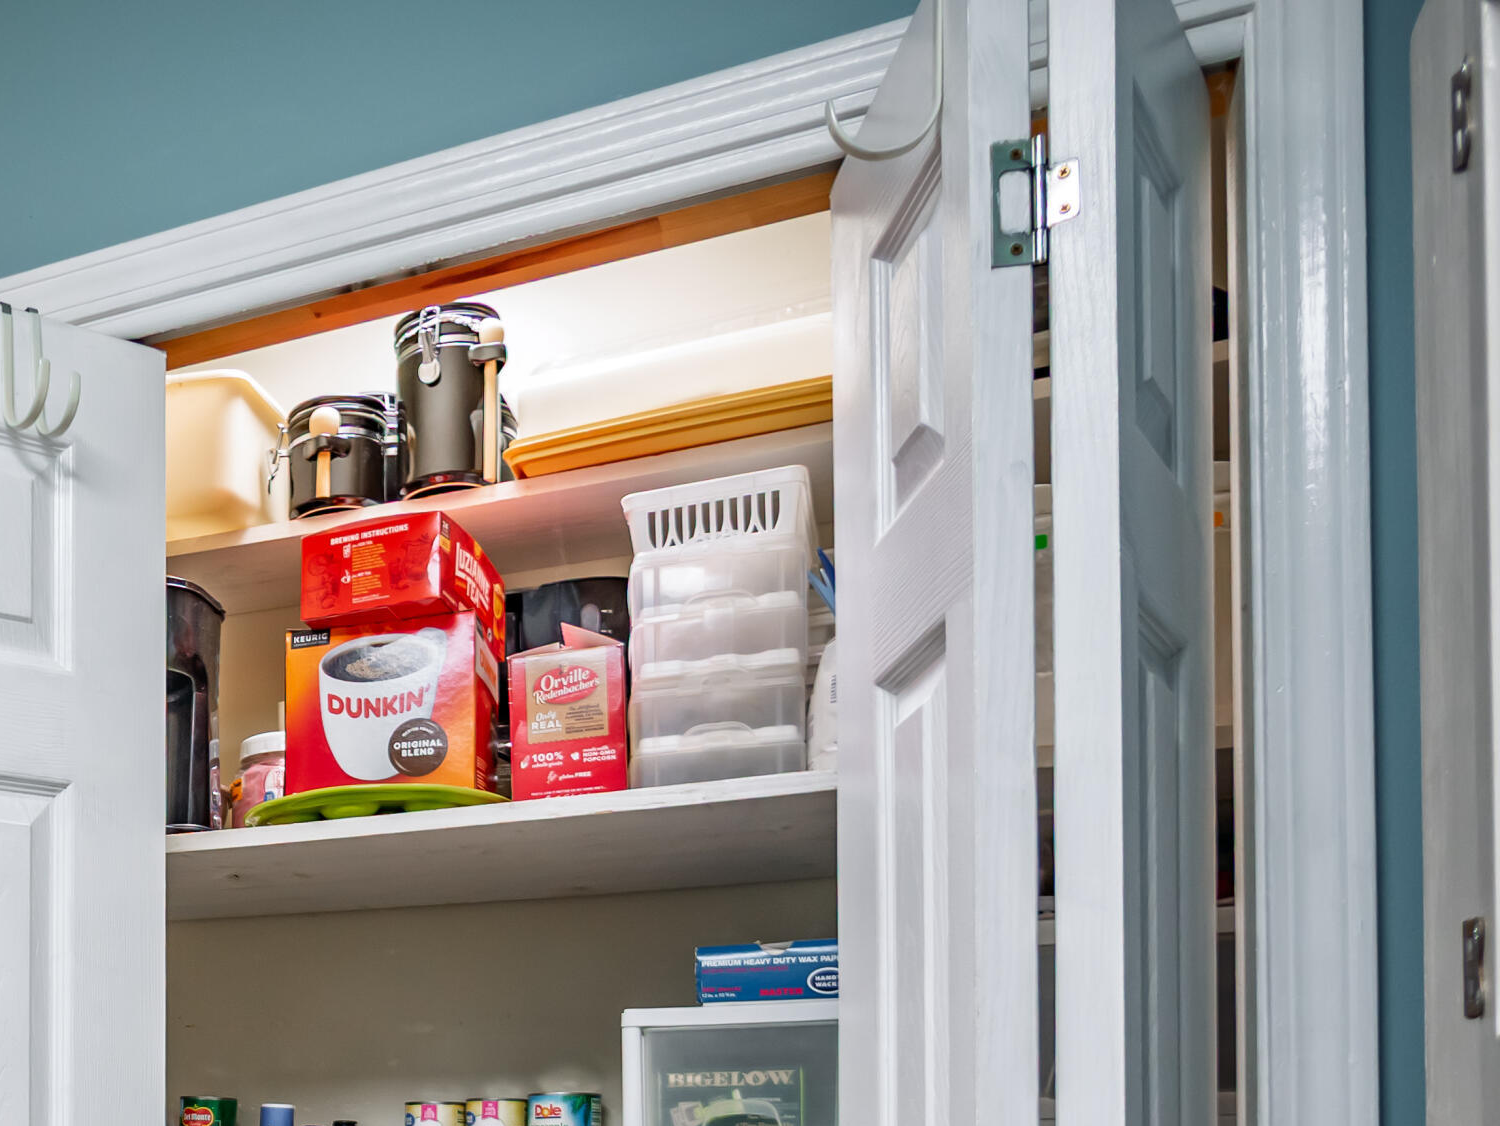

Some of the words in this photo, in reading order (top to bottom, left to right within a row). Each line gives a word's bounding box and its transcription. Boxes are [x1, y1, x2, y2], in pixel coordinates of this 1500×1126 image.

[330, 533, 360, 546] BREWING
[360, 523, 409, 539] INSTRUCTIONS
[455, 542, 490, 603] LUZIANNE
[466, 577, 489, 611] TEA
[293, 633, 328, 644] KEURIG
[540, 668, 590, 691] Orville
[533, 676, 600, 705] Redenbacher's
[327, 684, 431, 719] DUNKIN'
[536, 711, 557, 722] Only
[532, 720, 563, 730] REAL
[393, 738, 443, 750] ORIGINAL
[401, 747, 435, 757] BLEND
[532, 751, 564, 763] 100%
[582, 749, 616, 757] NON-GMO
[583, 755, 617, 763] POPCORN
[701, 959, 741, 968] PREMIUM
[743, 958, 770, 966] HEAVY
[772, 956, 796, 964] DUTY
[798, 955, 818, 963] WAX
[820, 954, 838, 962] PAP
[760, 988, 803, 996] MASTER
[667, 1070, 796, 1088] BIGELOW
[535, 1104, 562, 1117] Dole
[191, 1113, 211, 1121] Monte
